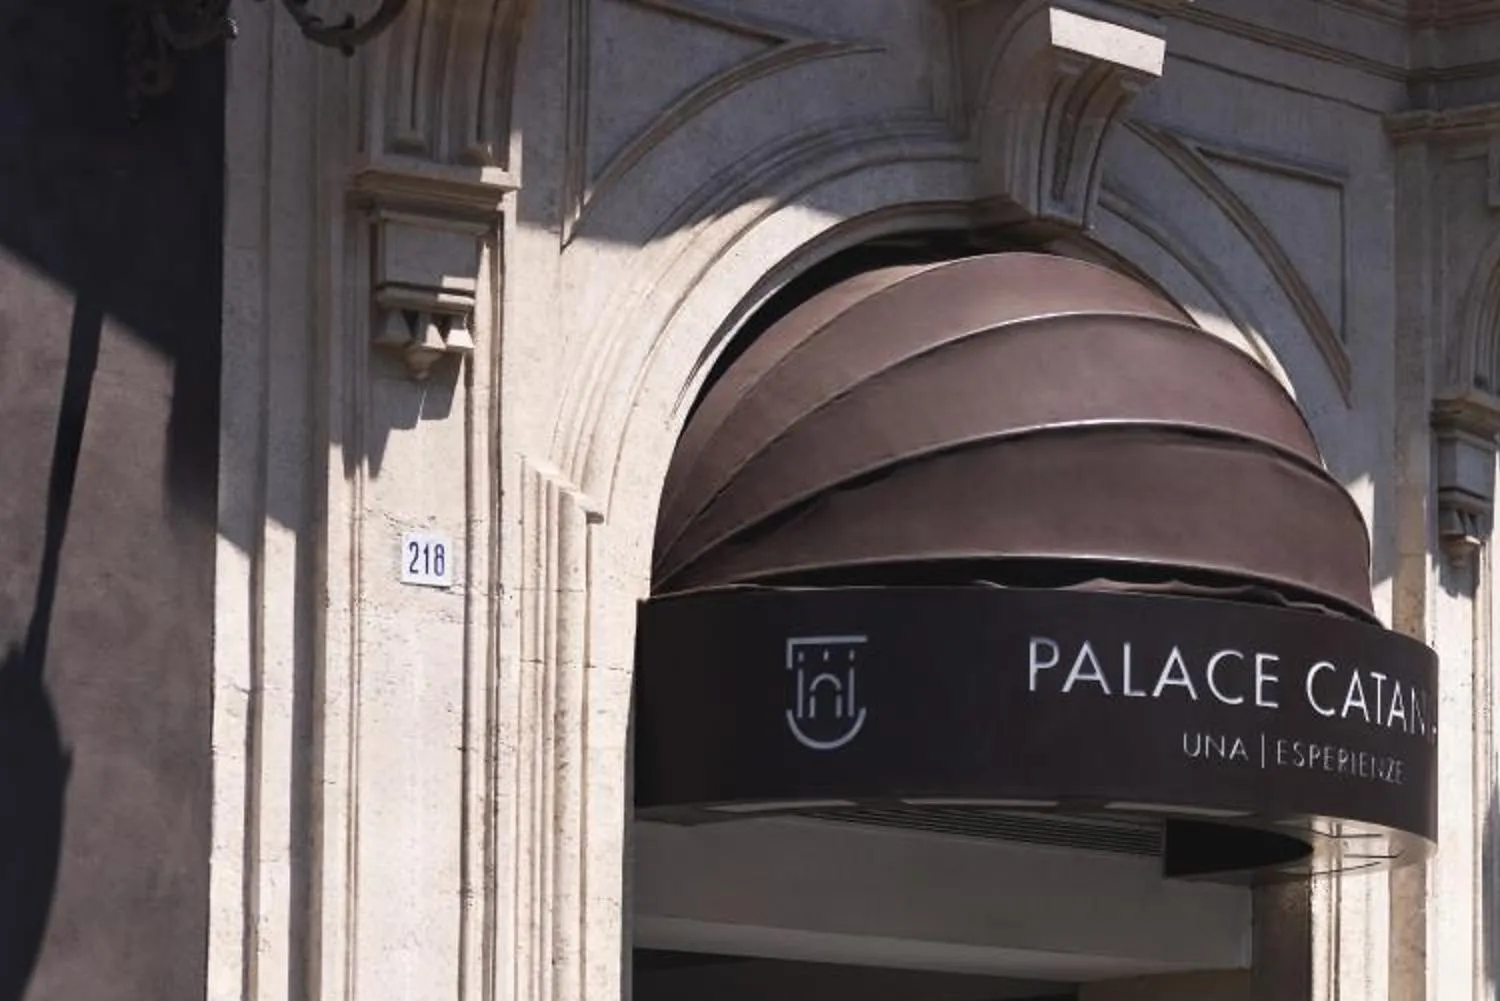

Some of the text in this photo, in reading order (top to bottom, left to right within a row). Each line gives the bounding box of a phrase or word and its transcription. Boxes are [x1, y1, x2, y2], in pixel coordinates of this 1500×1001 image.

[408, 541, 445, 577] 218
[1028, 636, 1437, 744] PALACE CATAN
[1183, 731, 1249, 761] UNA
